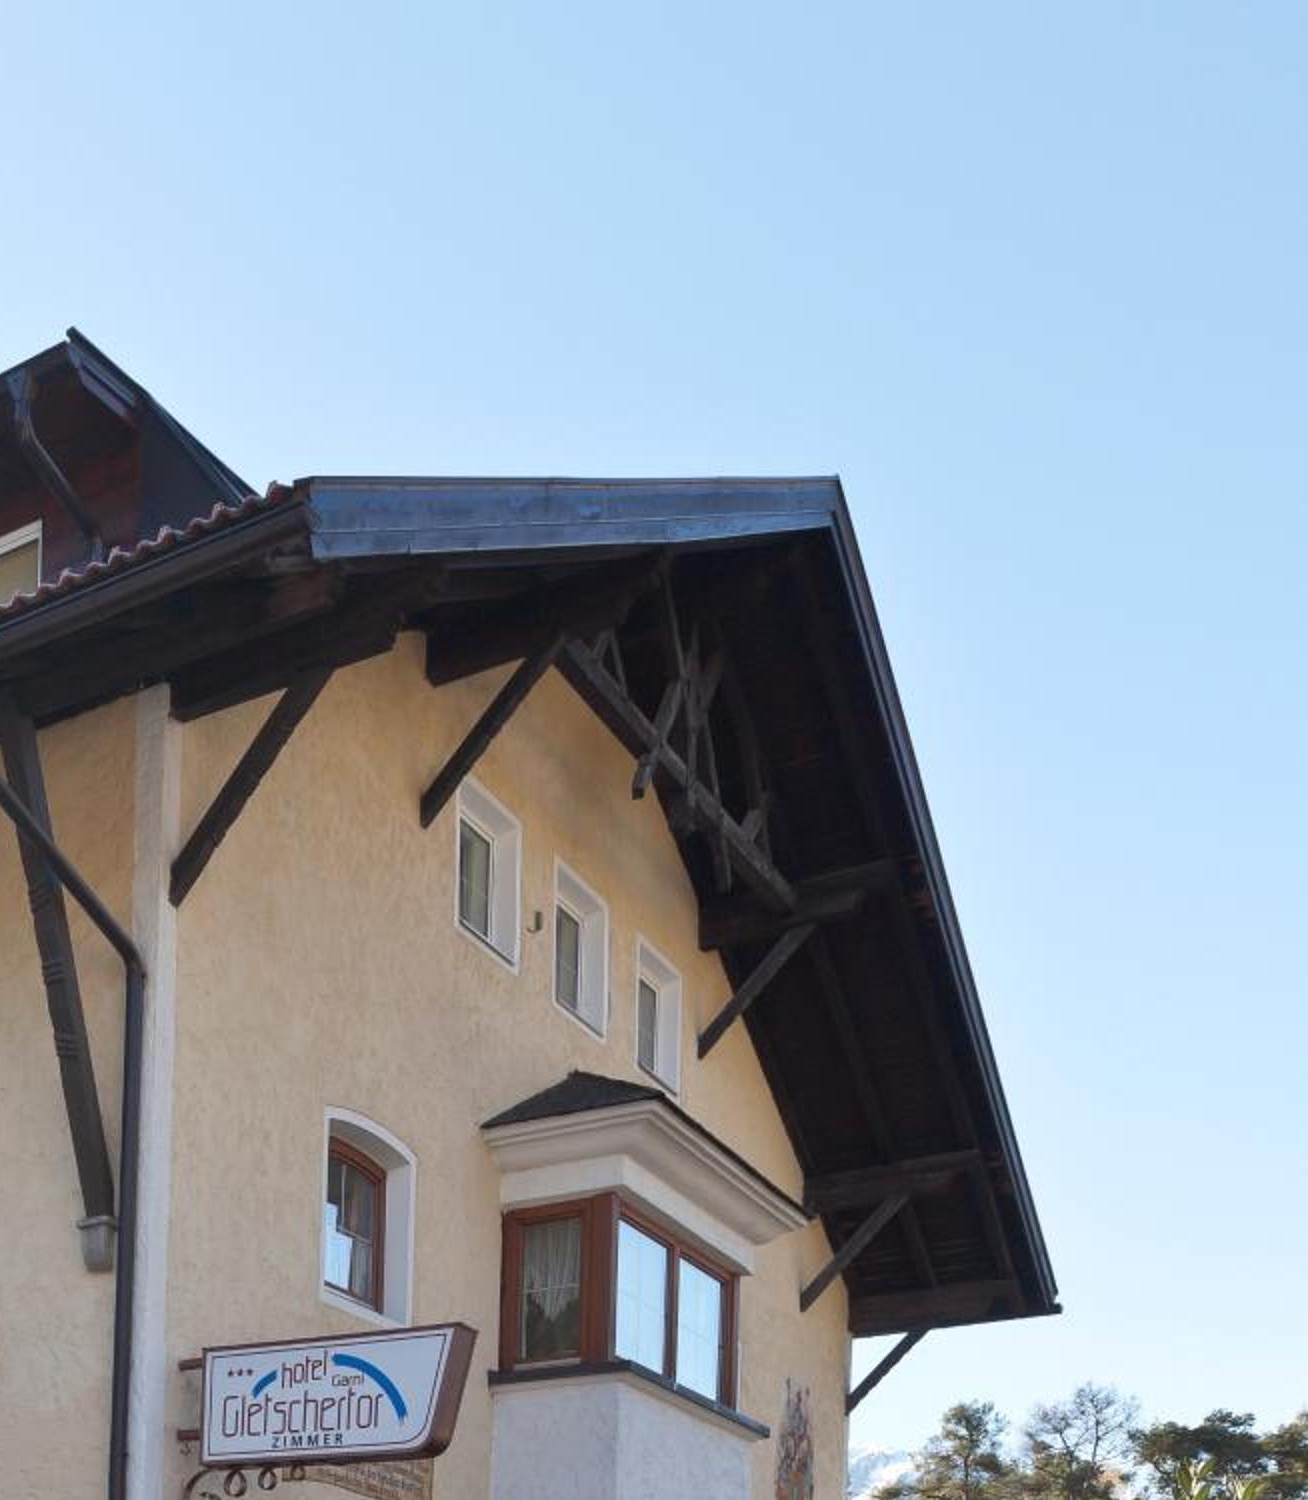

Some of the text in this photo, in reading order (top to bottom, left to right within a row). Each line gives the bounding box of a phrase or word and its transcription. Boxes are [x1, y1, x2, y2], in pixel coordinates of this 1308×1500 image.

[281, 1350, 328, 1388] hotel
[332, 1373, 365, 1387] Garni
[222, 1387, 384, 1437] Gletschertor
[271, 1433, 343, 1449] ZIMMER
